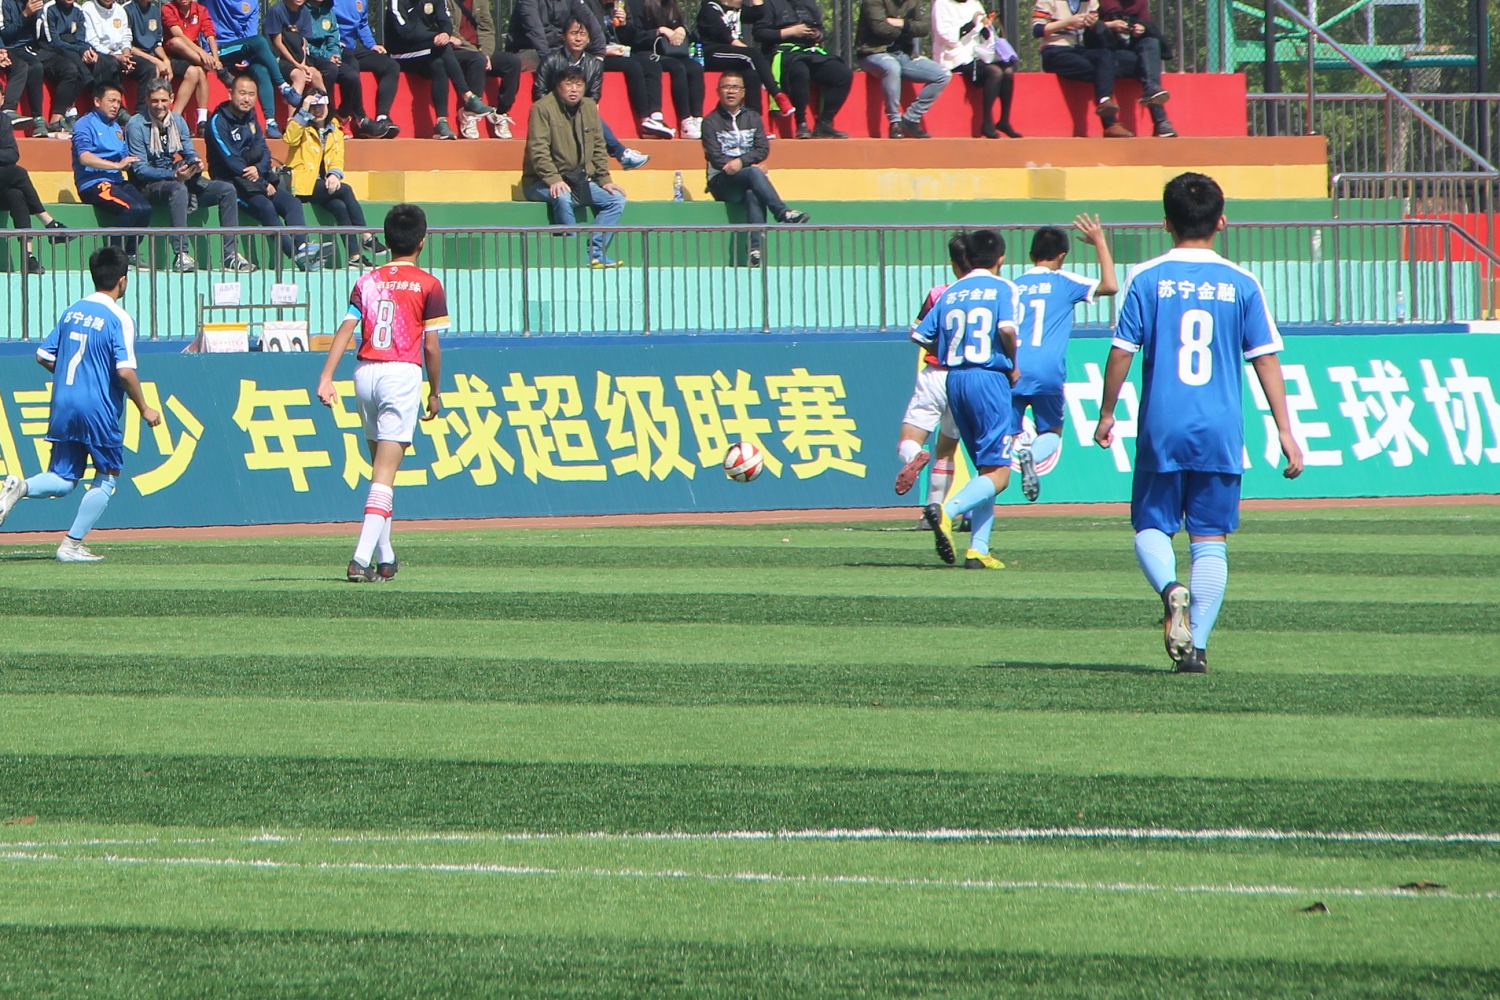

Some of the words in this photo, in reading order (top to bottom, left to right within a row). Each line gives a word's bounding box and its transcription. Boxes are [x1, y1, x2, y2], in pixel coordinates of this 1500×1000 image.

[945, 287, 998, 305] 苏宁金融
[1157, 279, 1237, 304] 苏宁金融
[371, 299, 395, 350] 8
[945, 306, 994, 367] 23
[1178, 308, 1215, 387] 8
[65, 331, 88, 386] 7
[1063, 358, 1499, 473] 中足球协
